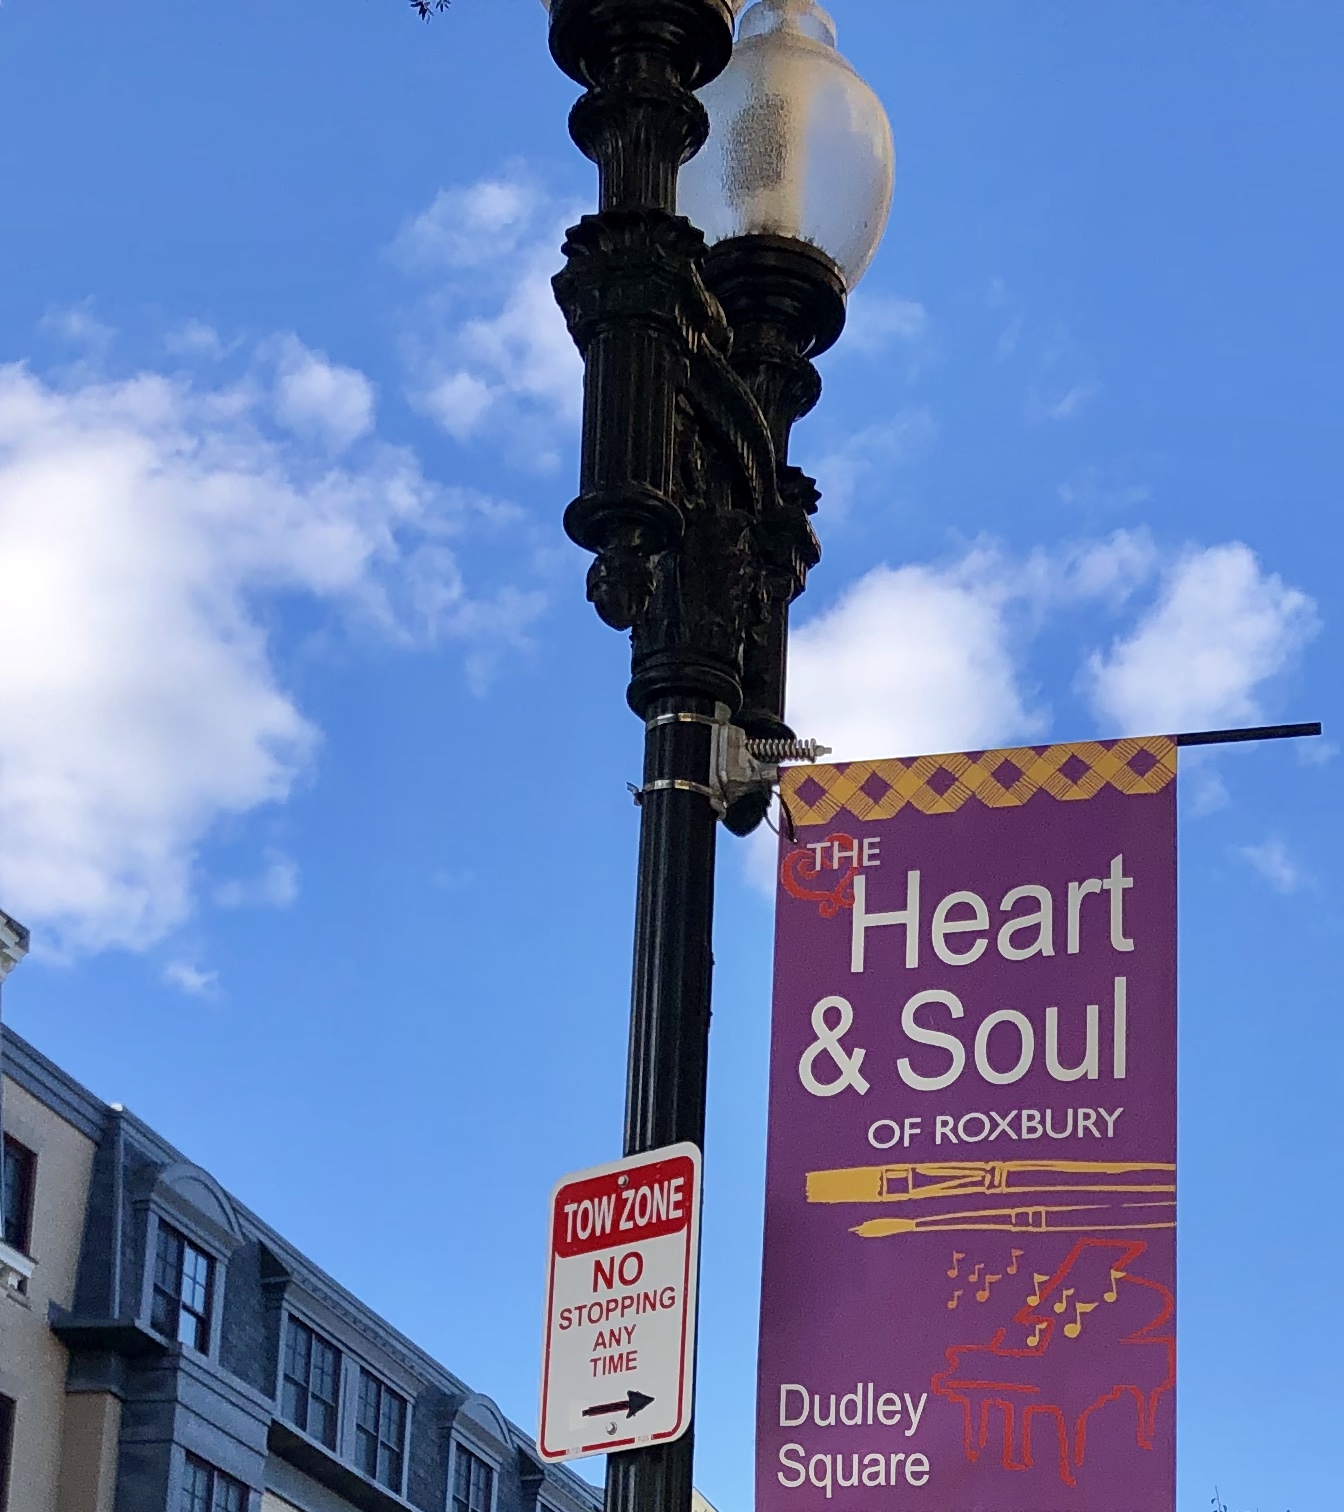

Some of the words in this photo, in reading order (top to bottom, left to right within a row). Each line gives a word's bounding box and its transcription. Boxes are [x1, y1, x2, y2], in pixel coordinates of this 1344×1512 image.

[807, 837, 881, 870] THE
[851, 853, 1135, 973] Heart
[799, 995, 870, 1096] &
[896, 976, 1127, 1091] Soul
[868, 1117, 921, 1149] OF
[935, 1107, 1124, 1145] ROXBURY
[563, 1193, 617, 1243] TOW
[618, 1176, 685, 1230] ZONE
[592, 1251, 644, 1293] NO
[558, 1286, 676, 1330] STOPPING
[592, 1324, 637, 1352] ANY
[589, 1350, 638, 1378] TIME
[779, 1382, 928, 1436] Dudley
[777, 1443, 930, 1498] Square
